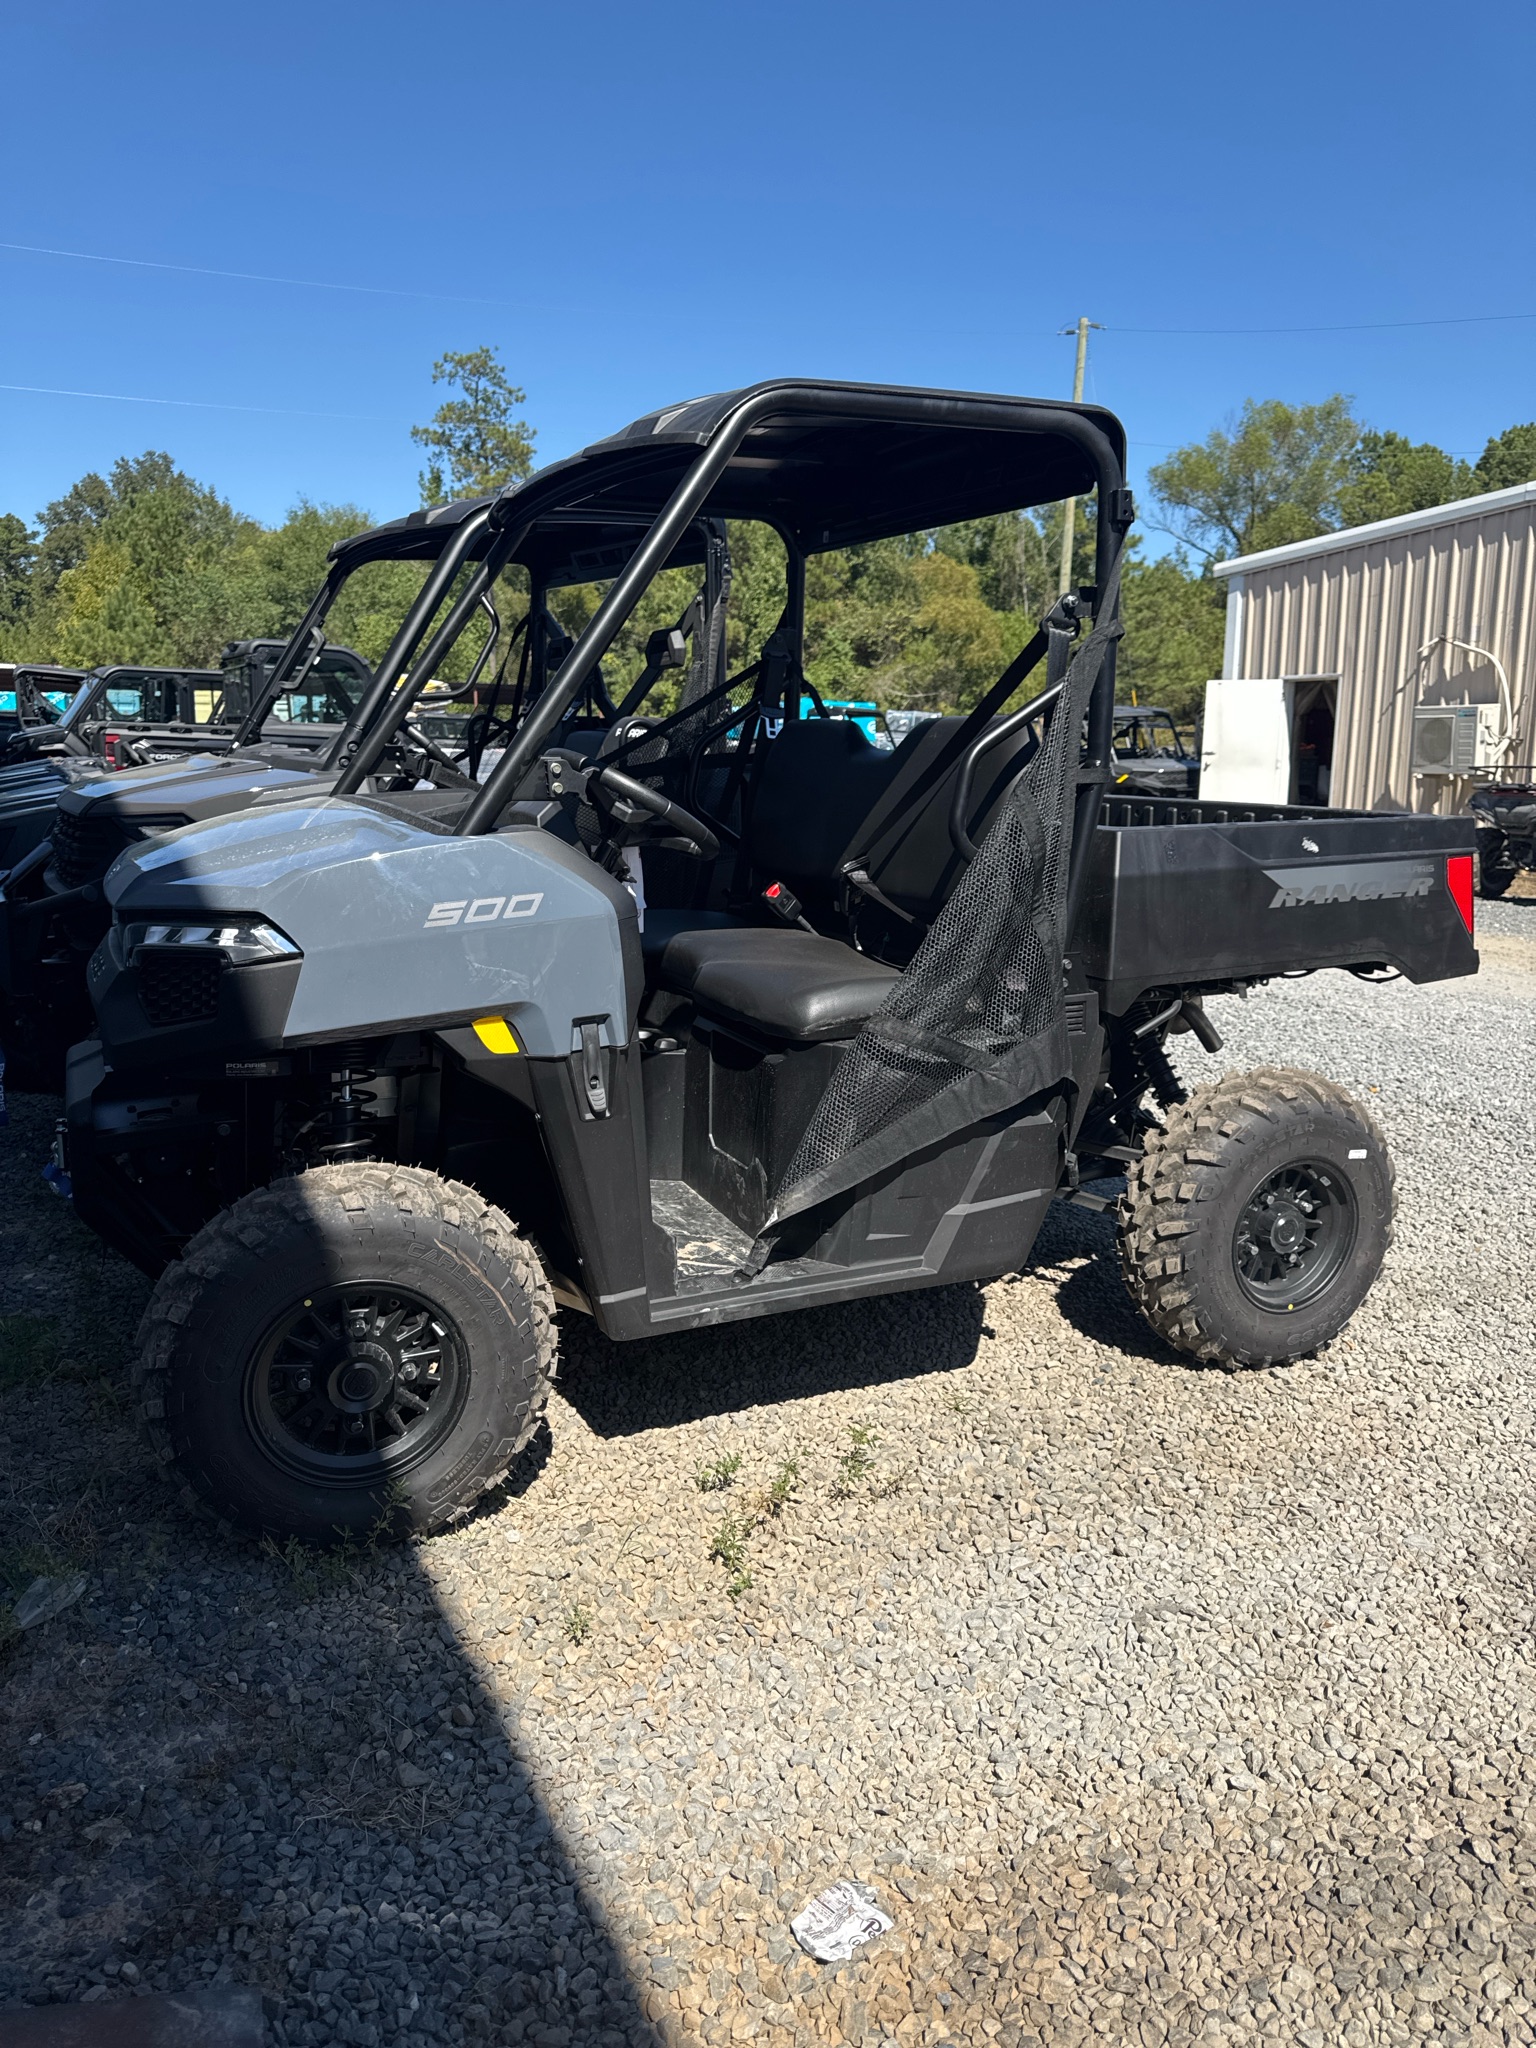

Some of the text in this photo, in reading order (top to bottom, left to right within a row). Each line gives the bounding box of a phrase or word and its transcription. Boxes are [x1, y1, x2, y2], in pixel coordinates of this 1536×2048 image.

[423, 893, 544, 928] 500
[1268, 877, 1435, 909] RANGER
[407, 1242, 506, 1325] CARLSTAR
